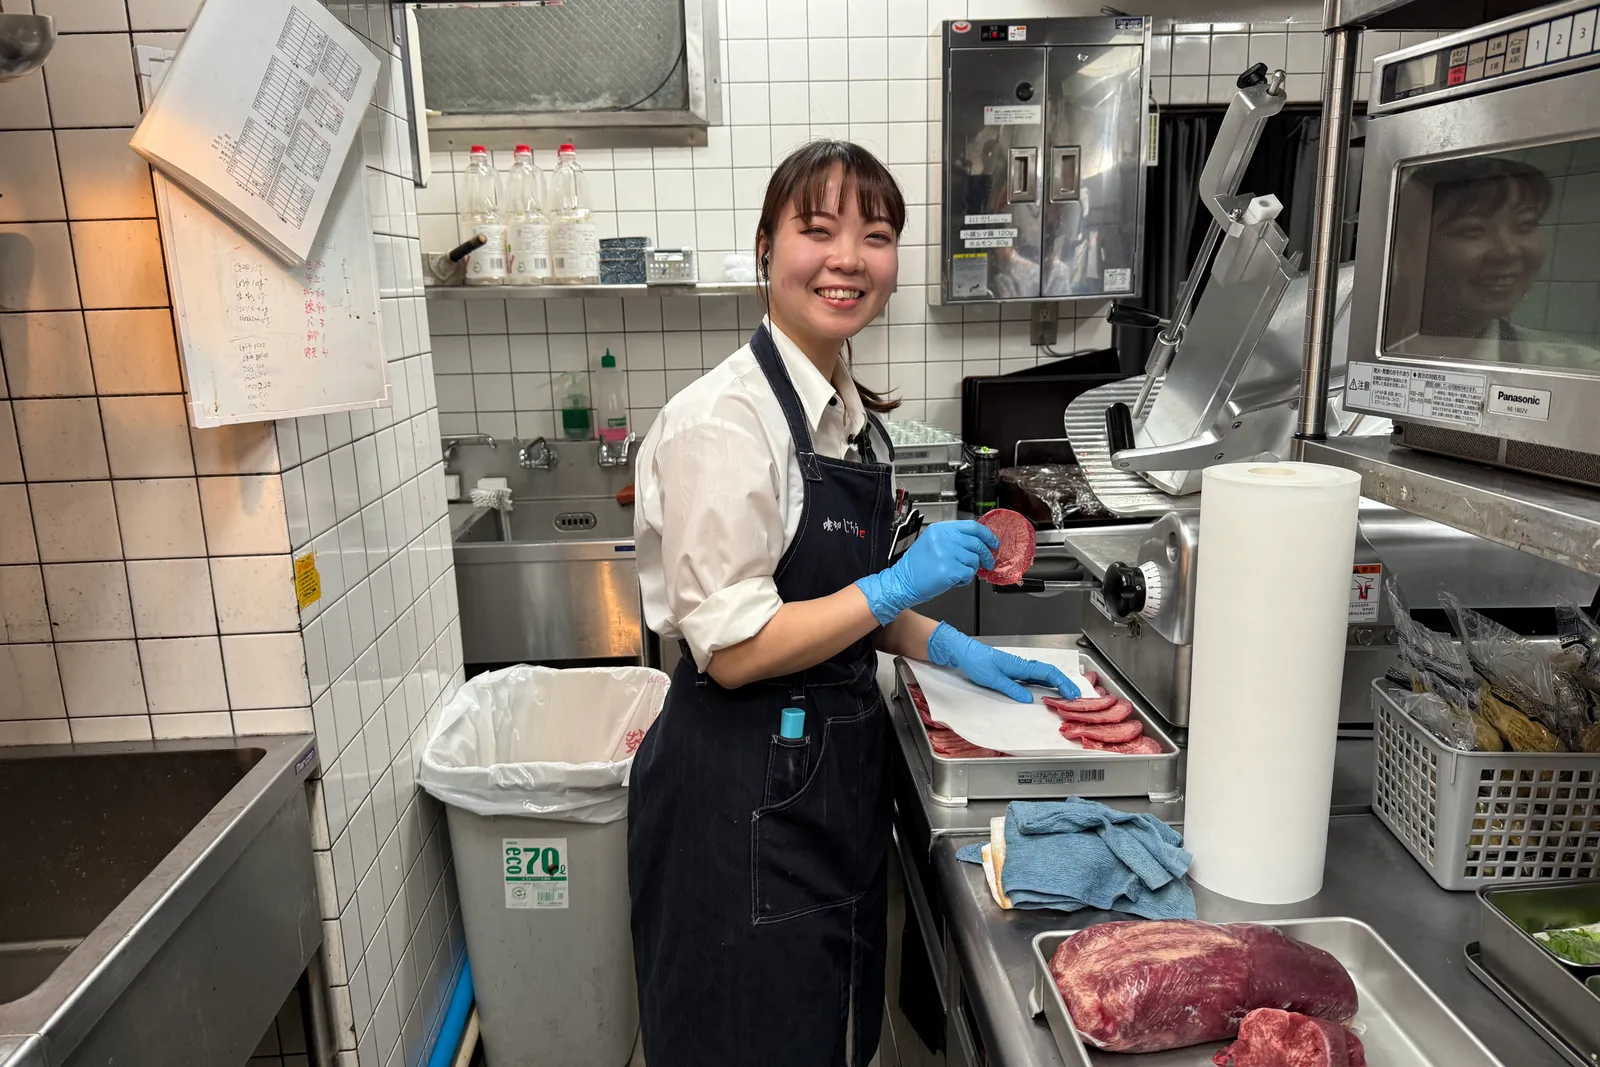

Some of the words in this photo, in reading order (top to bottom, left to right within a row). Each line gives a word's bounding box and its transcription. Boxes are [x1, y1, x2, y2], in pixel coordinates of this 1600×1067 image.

[1580, 28, 1586, 38] 3
[1556, 34, 1562, 44] 2
[1536, 40, 1540, 50] 1
[998, 230, 1014, 238] 120g
[1358, 380, 1370, 391] 注意
[1498, 391, 1540, 406] Panasonic
[506, 847, 522, 874] eco
